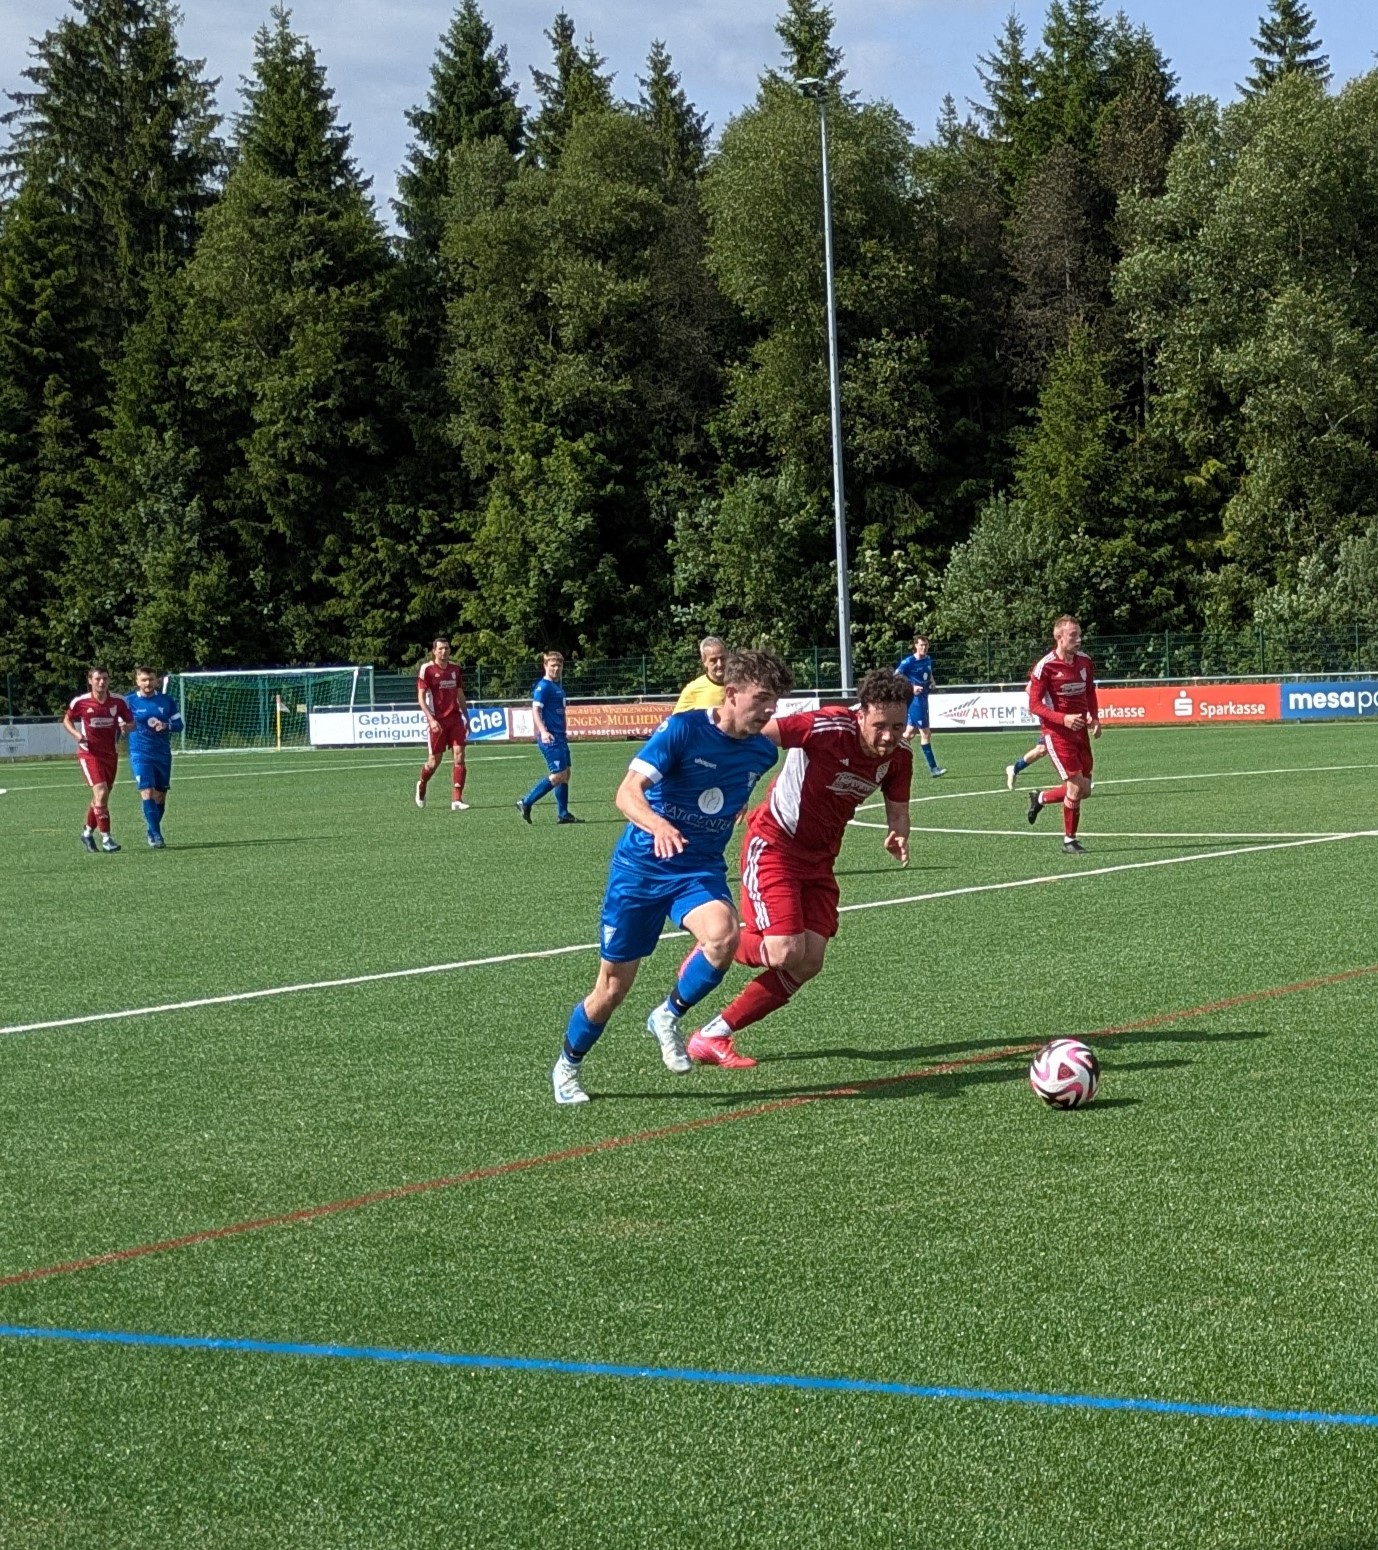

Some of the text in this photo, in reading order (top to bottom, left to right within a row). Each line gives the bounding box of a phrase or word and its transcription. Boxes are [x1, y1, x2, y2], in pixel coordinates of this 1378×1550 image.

[971, 706, 1015, 719] ARTEM
[1098, 705, 1145, 717] arkasse
[1200, 702, 1266, 718] Sparkasse
[358, 713, 429, 726] Gebäude
[469, 711, 502, 733] che
[359, 727, 429, 741] reinigung
